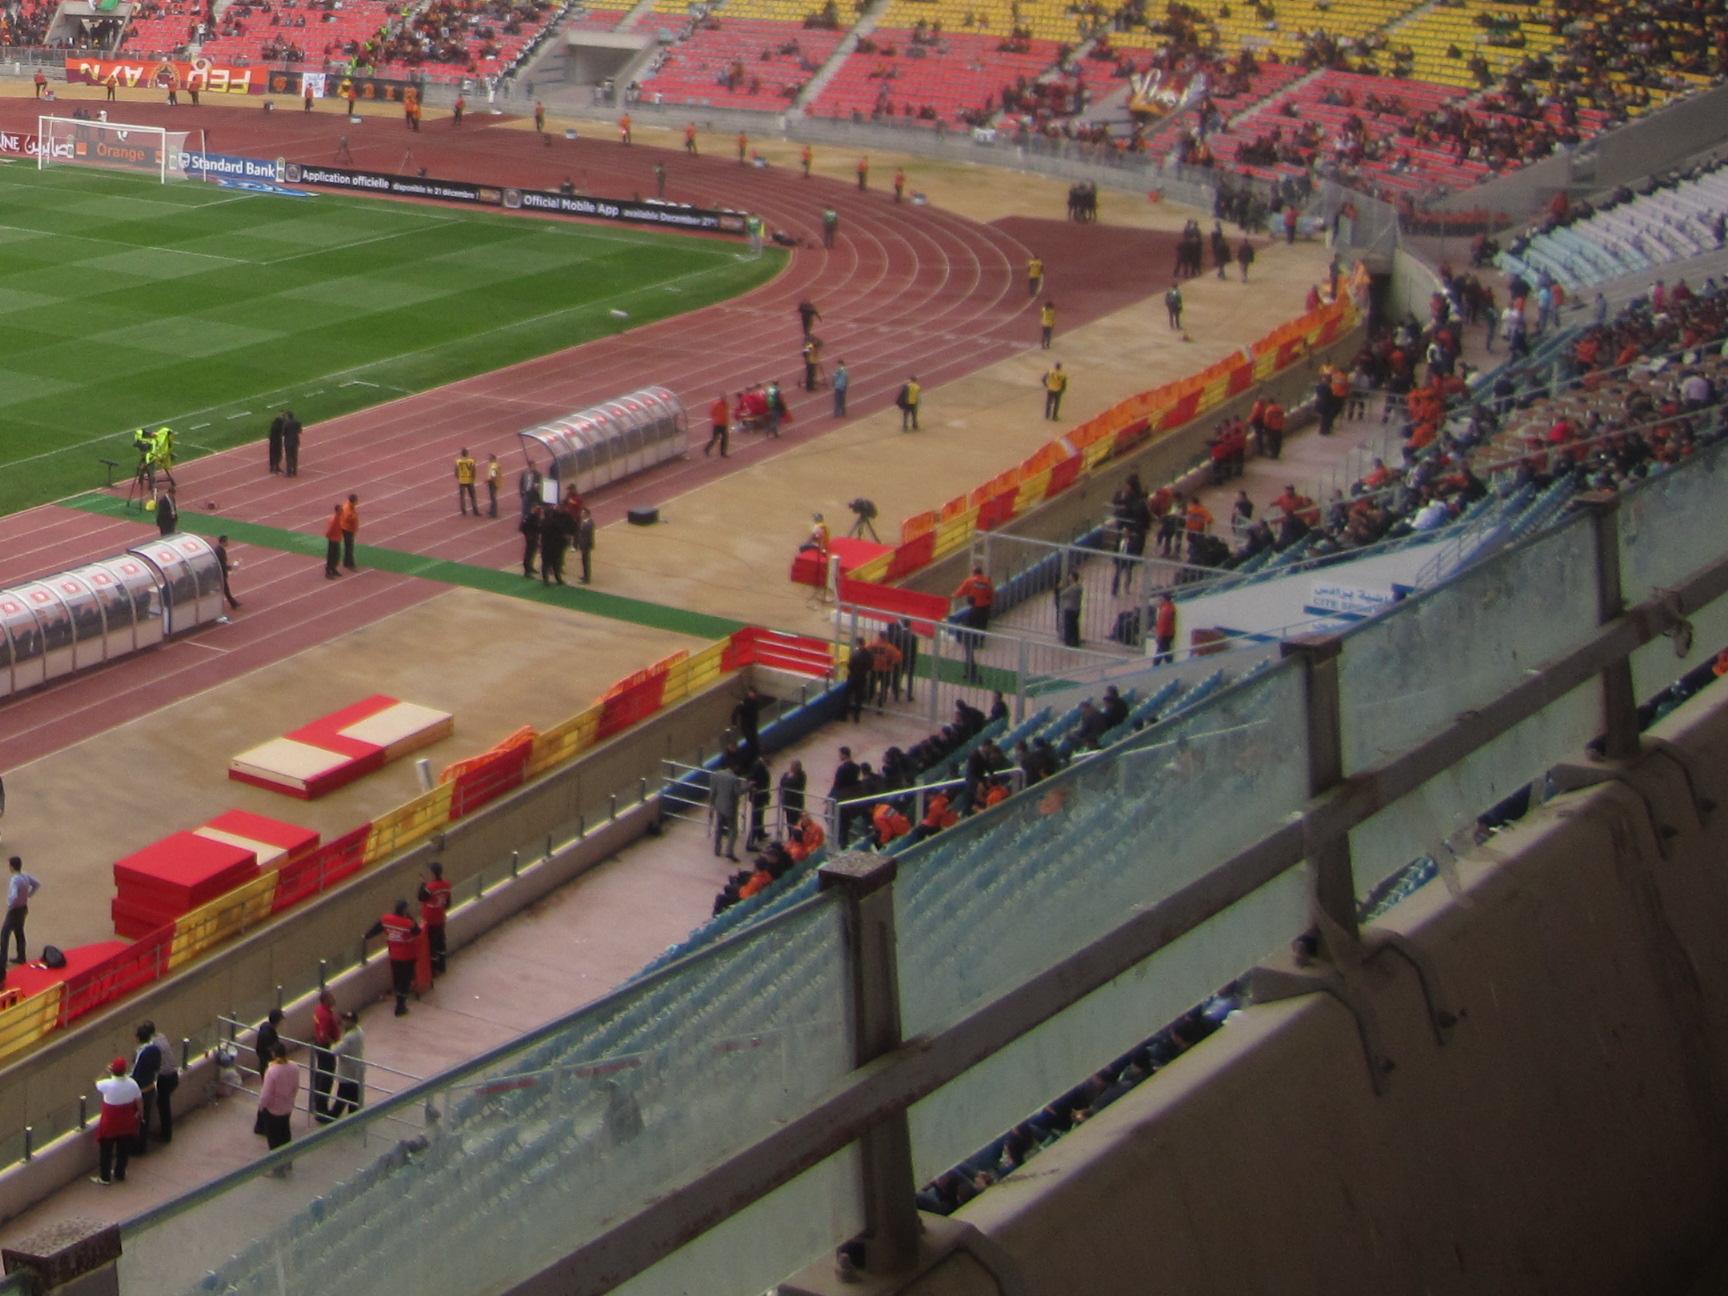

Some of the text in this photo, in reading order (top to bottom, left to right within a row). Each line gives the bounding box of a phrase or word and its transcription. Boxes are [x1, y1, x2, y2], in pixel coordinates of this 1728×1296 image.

[96, 143, 145, 161] Orange
[191, 155, 276, 178] Standard Bank
[302, 170, 350, 186] Application
[352, 176, 390, 189] officielle
[524, 195, 560, 209] Official
[562, 199, 595, 213] Mobile
[597, 204, 619, 218] App
